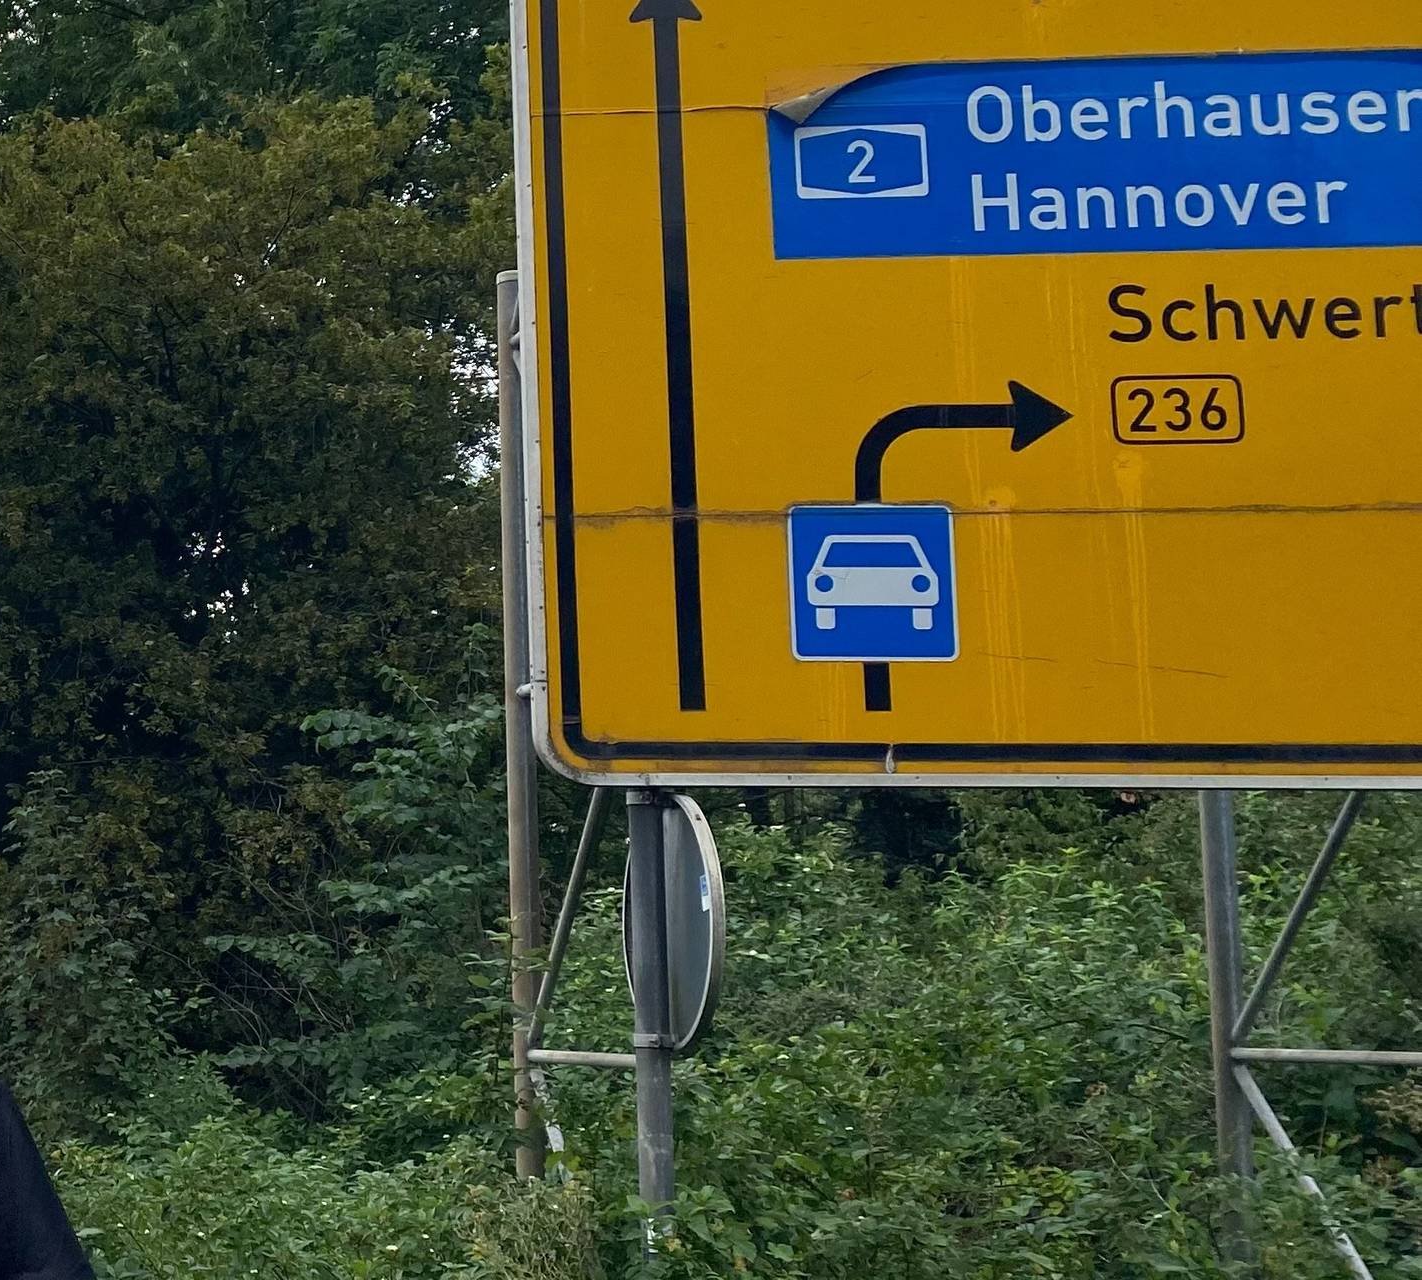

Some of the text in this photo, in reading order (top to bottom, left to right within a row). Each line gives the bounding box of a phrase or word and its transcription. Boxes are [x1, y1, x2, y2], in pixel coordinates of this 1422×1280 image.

[846, 141, 876, 184] 2
[970, 172, 1347, 232] Hannover
[1109, 283, 1422, 343] Schwert
[1128, 389, 1228, 433] 236
